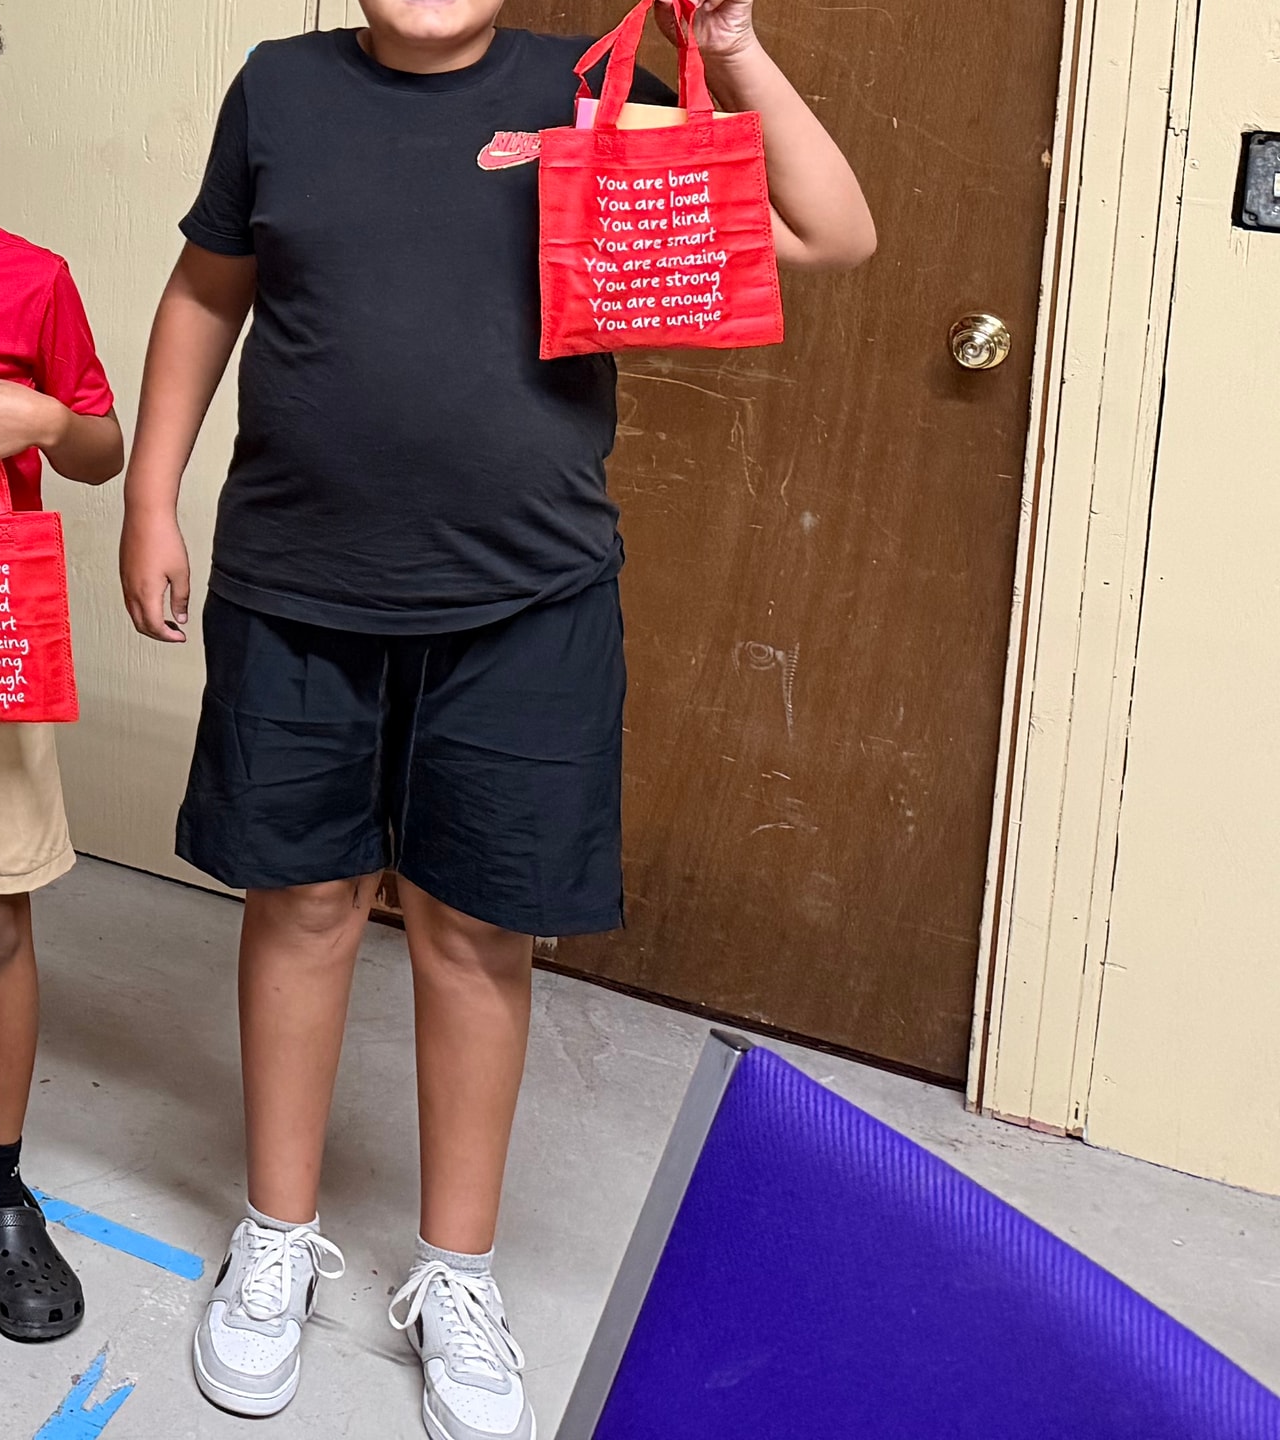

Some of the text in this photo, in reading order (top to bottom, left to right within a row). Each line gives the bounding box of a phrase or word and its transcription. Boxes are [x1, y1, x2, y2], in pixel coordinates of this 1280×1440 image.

[489, 132, 541, 153] NIKE
[596, 170, 709, 190] You are brave
[599, 207, 710, 232] You are kind
[593, 228, 716, 253] You are smart
[584, 249, 727, 273] You are amazing
[594, 310, 721, 332] You are unique
